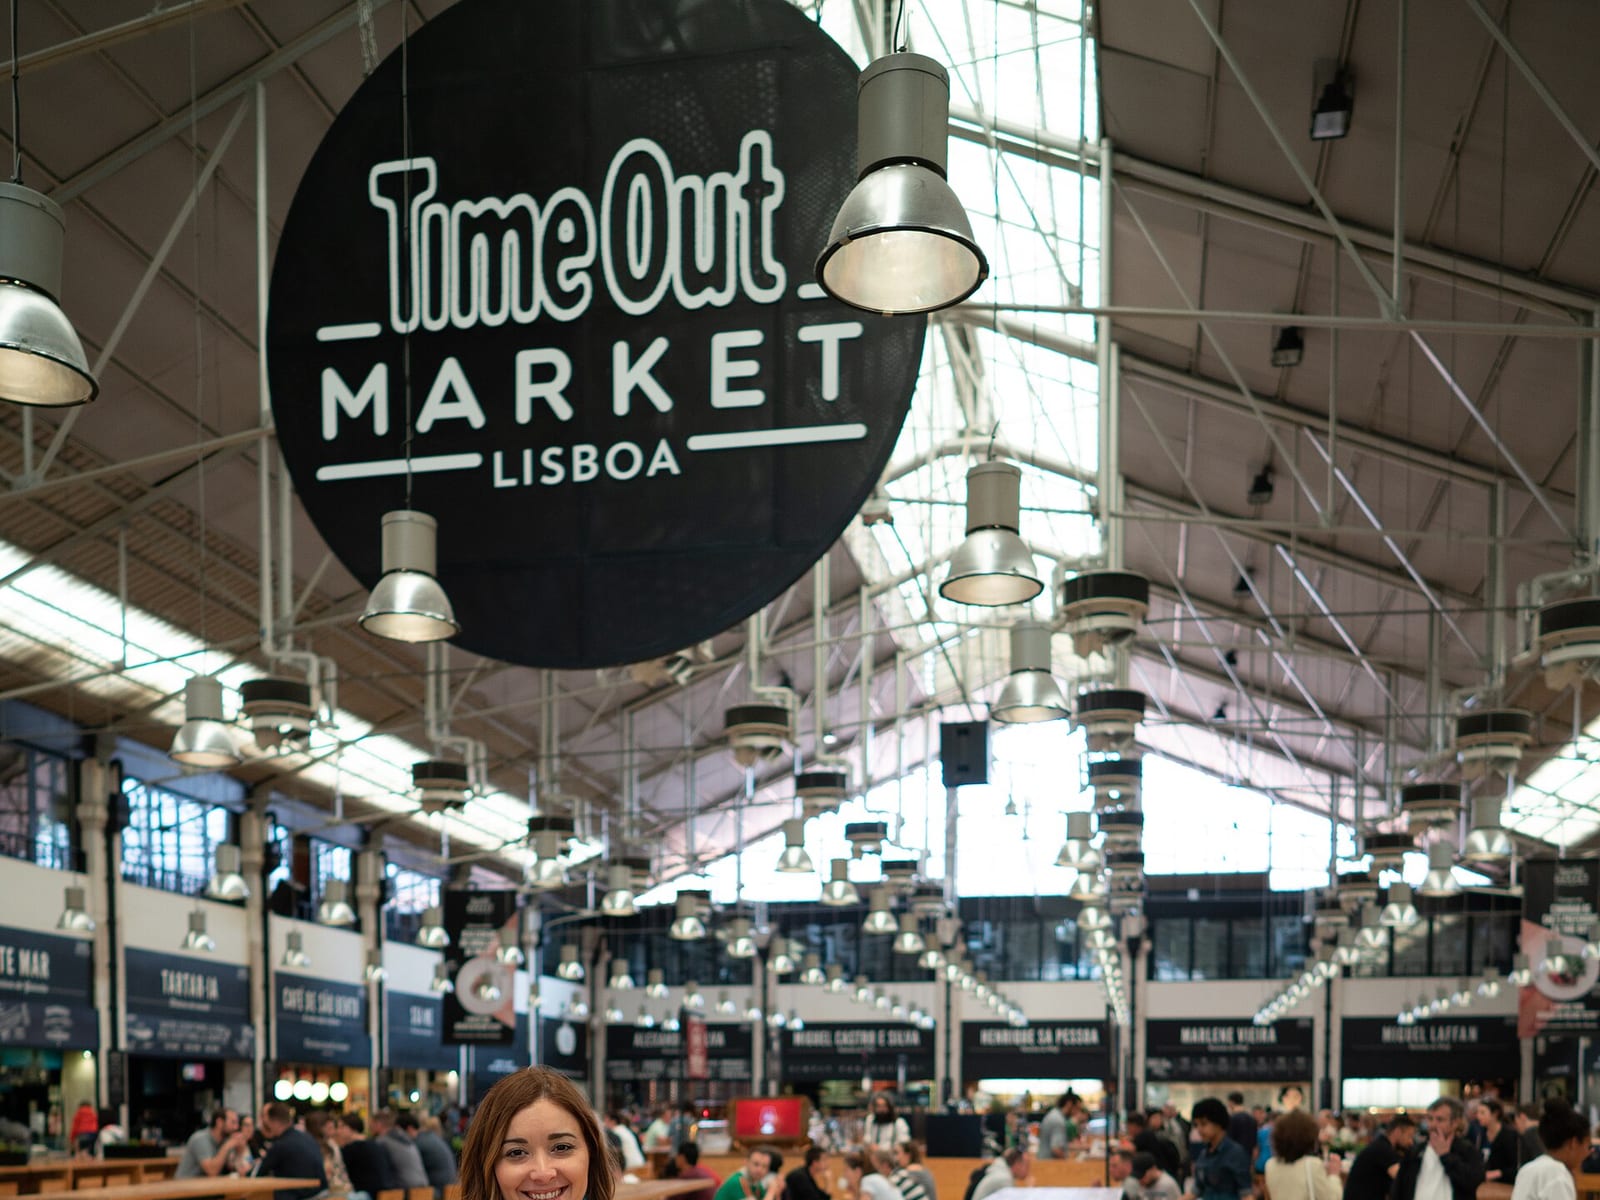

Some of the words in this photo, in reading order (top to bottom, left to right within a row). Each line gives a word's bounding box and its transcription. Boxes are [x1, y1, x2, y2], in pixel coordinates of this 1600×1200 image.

[369, 156, 597, 334] Time
[601, 129, 787, 316] Out
[320, 321, 863, 442] MARKET
[493, 438, 682, 489] LISBOA
[18, 947, 51, 980] MAR
